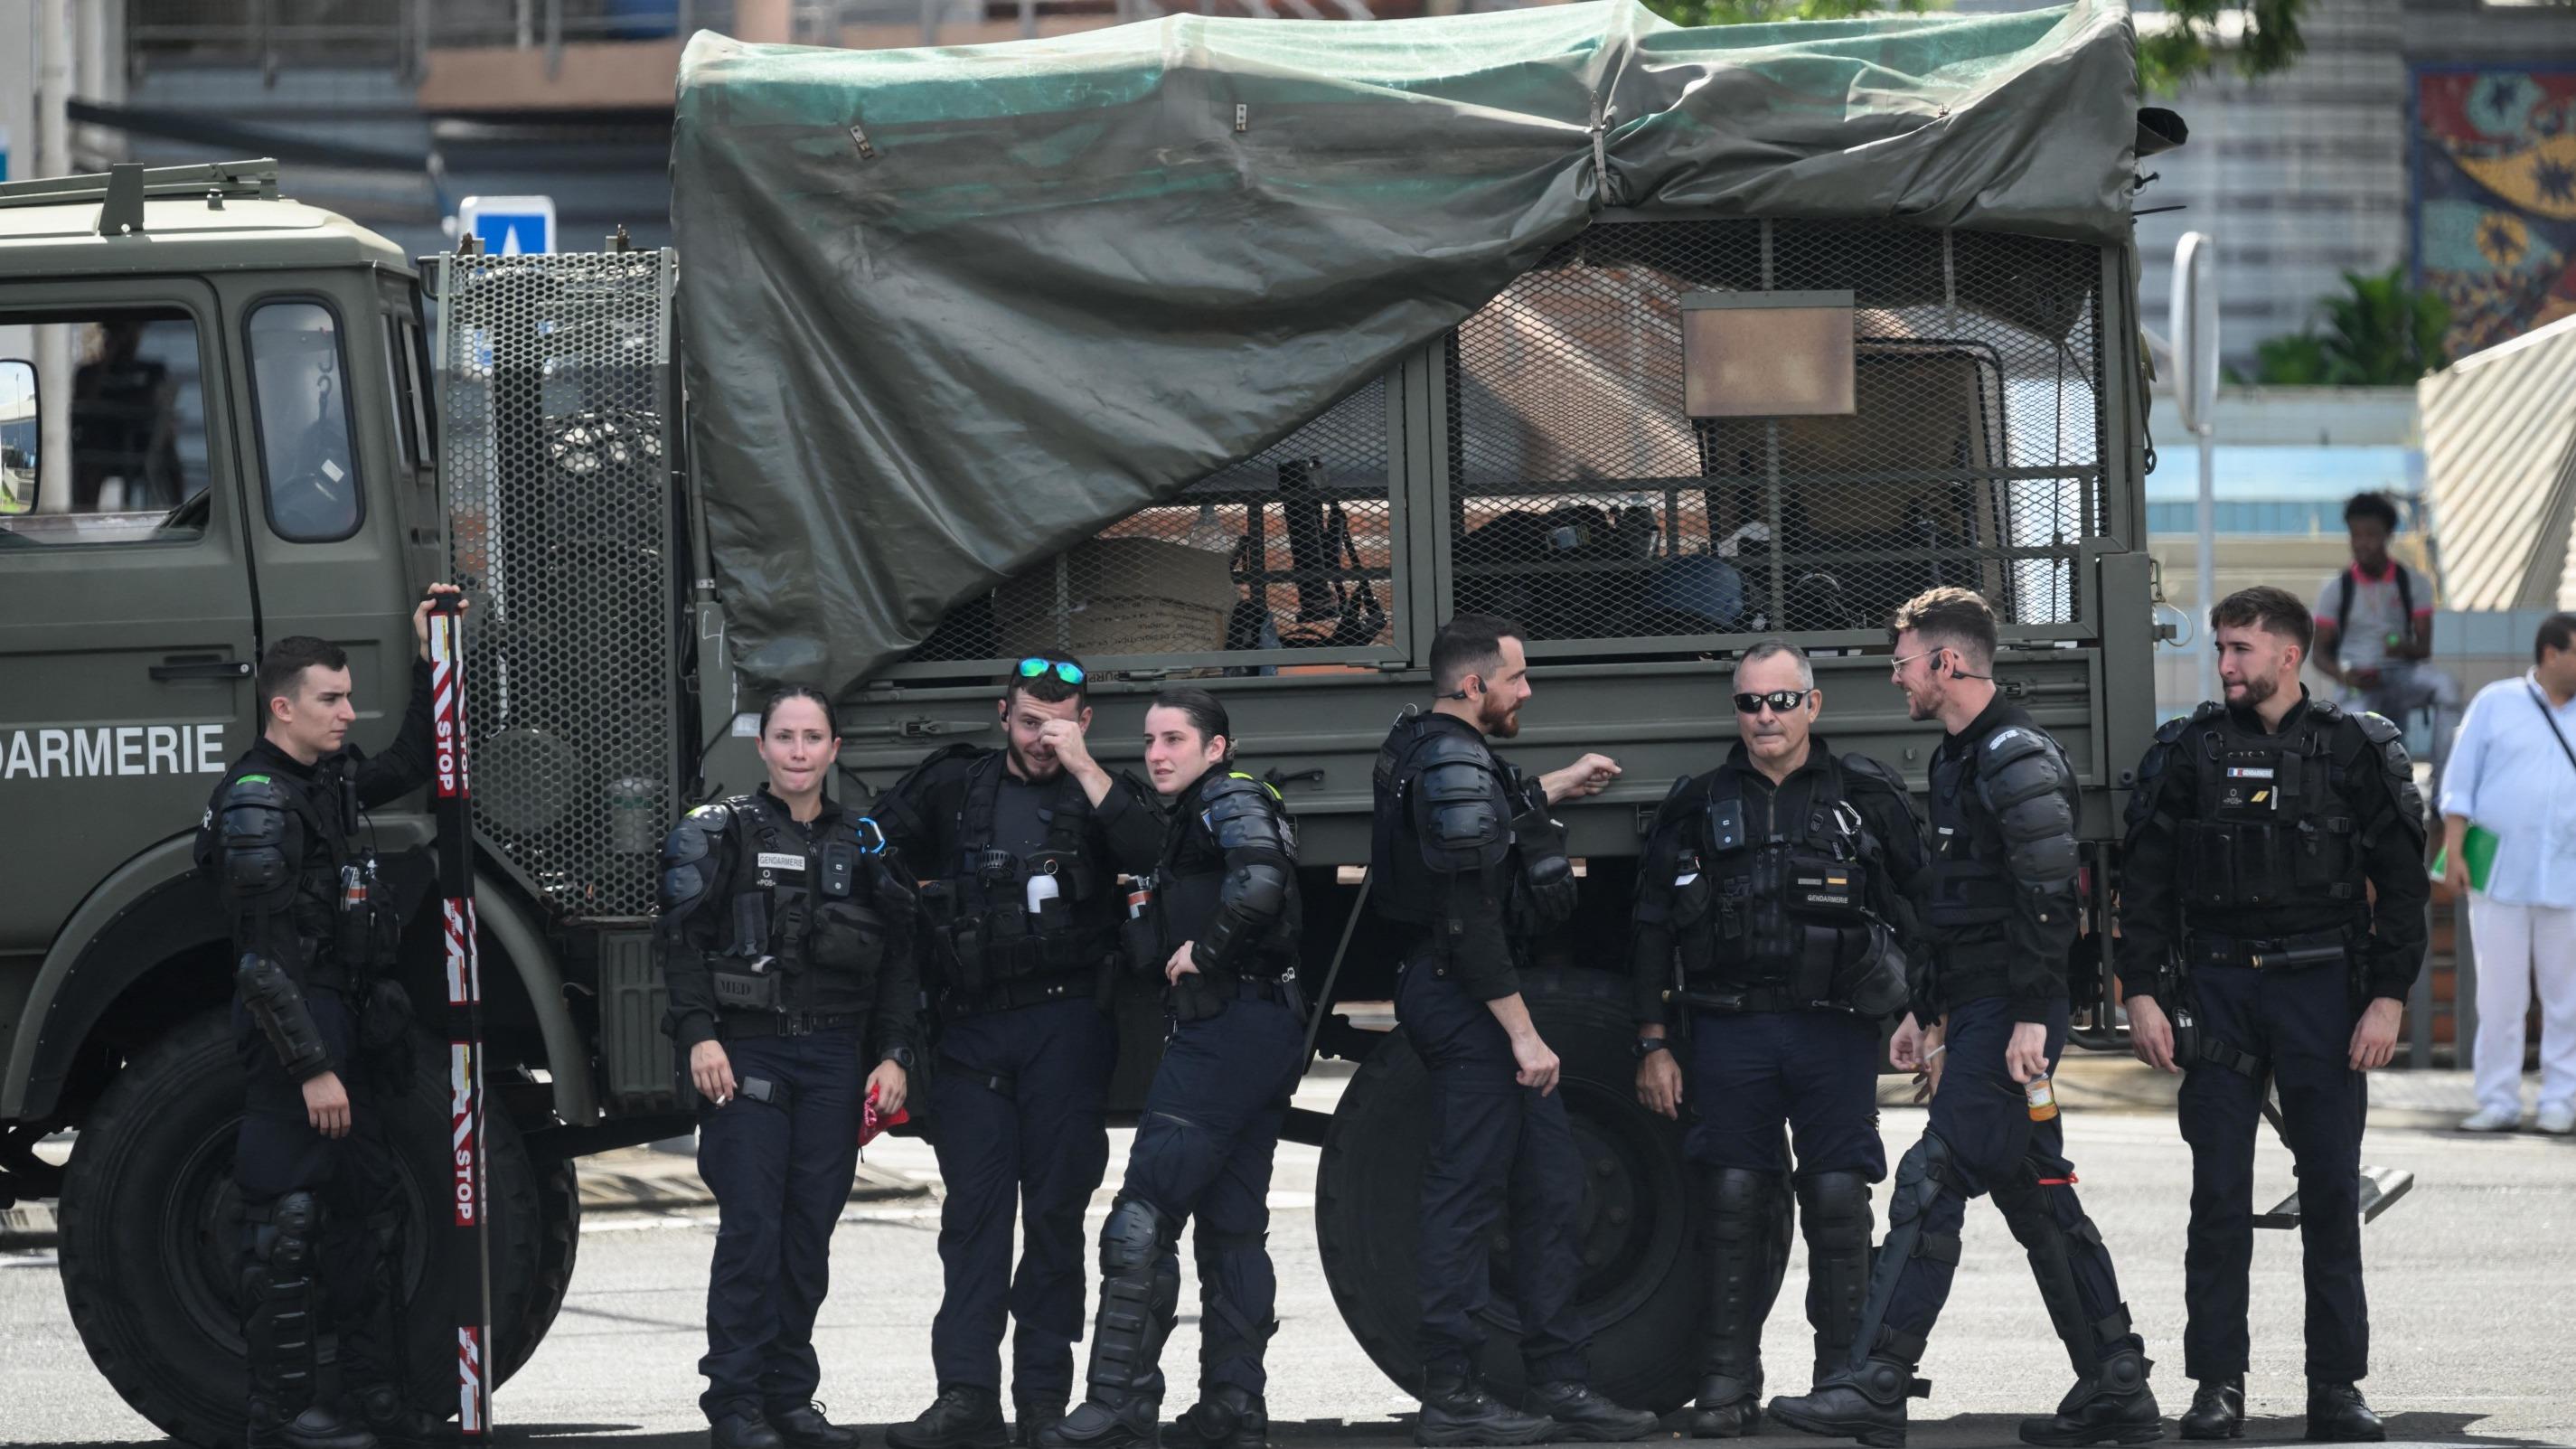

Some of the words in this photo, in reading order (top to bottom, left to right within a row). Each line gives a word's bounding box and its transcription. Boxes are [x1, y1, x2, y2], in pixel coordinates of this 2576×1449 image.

[0, 724, 226, 779] ARMERIE
[437, 720, 454, 790] STOP
[459, 720, 469, 790] STOP
[759, 856, 804, 868] GENDARMERIE
[1807, 894, 1848, 904] GENDARMERIE
[456, 1150, 472, 1218] STOP
